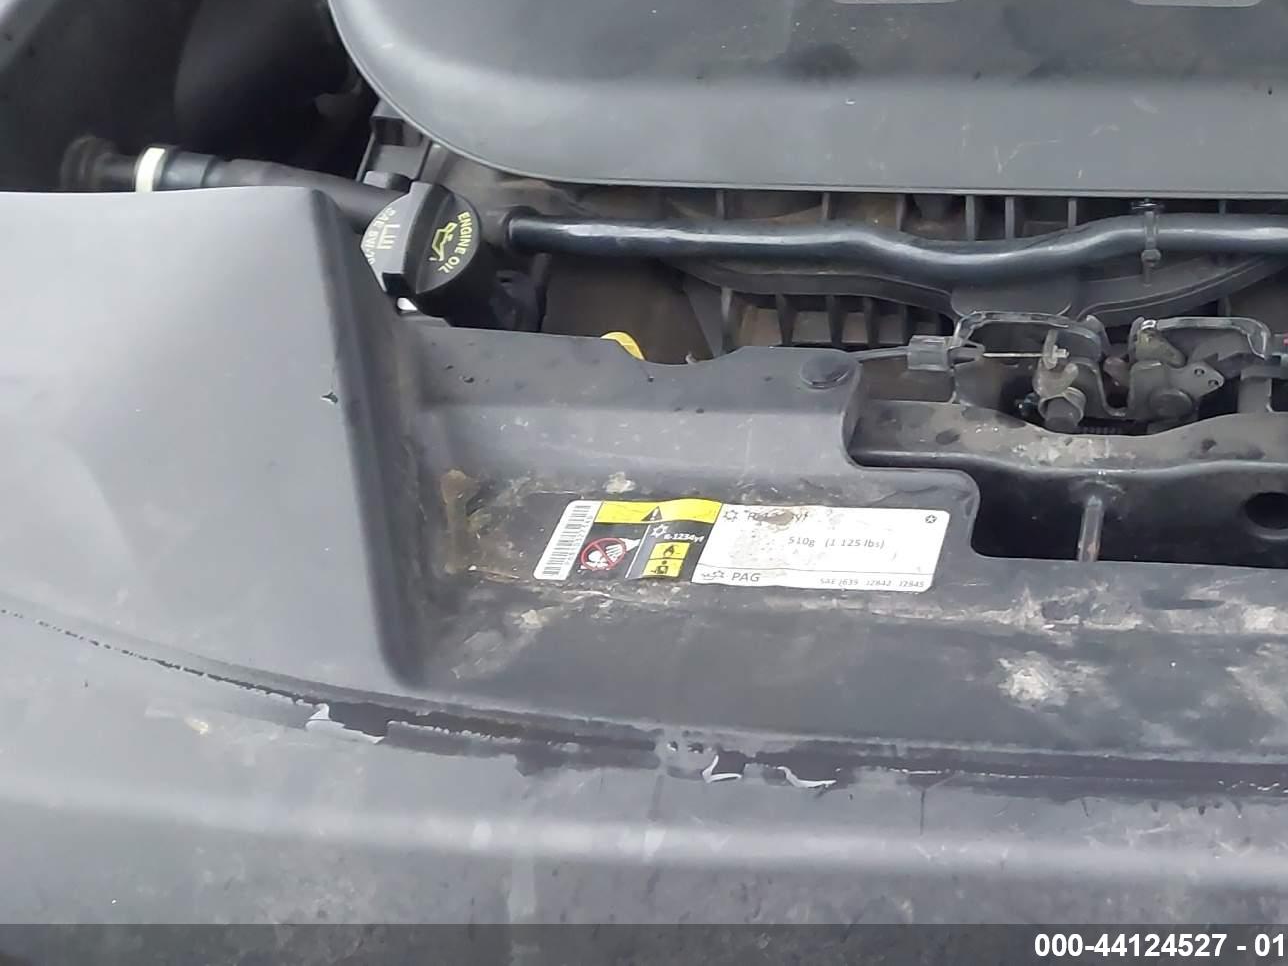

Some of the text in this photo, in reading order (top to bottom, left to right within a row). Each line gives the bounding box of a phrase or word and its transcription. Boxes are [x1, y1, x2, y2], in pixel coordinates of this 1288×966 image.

[373, 207, 396, 226] SAE
[438, 211, 473, 273] ENGINE OIL
[787, 536, 885, 550] 510g (1125 lbs)
[730, 572, 761, 583] PAG
[819, 577, 836, 585] SAE
